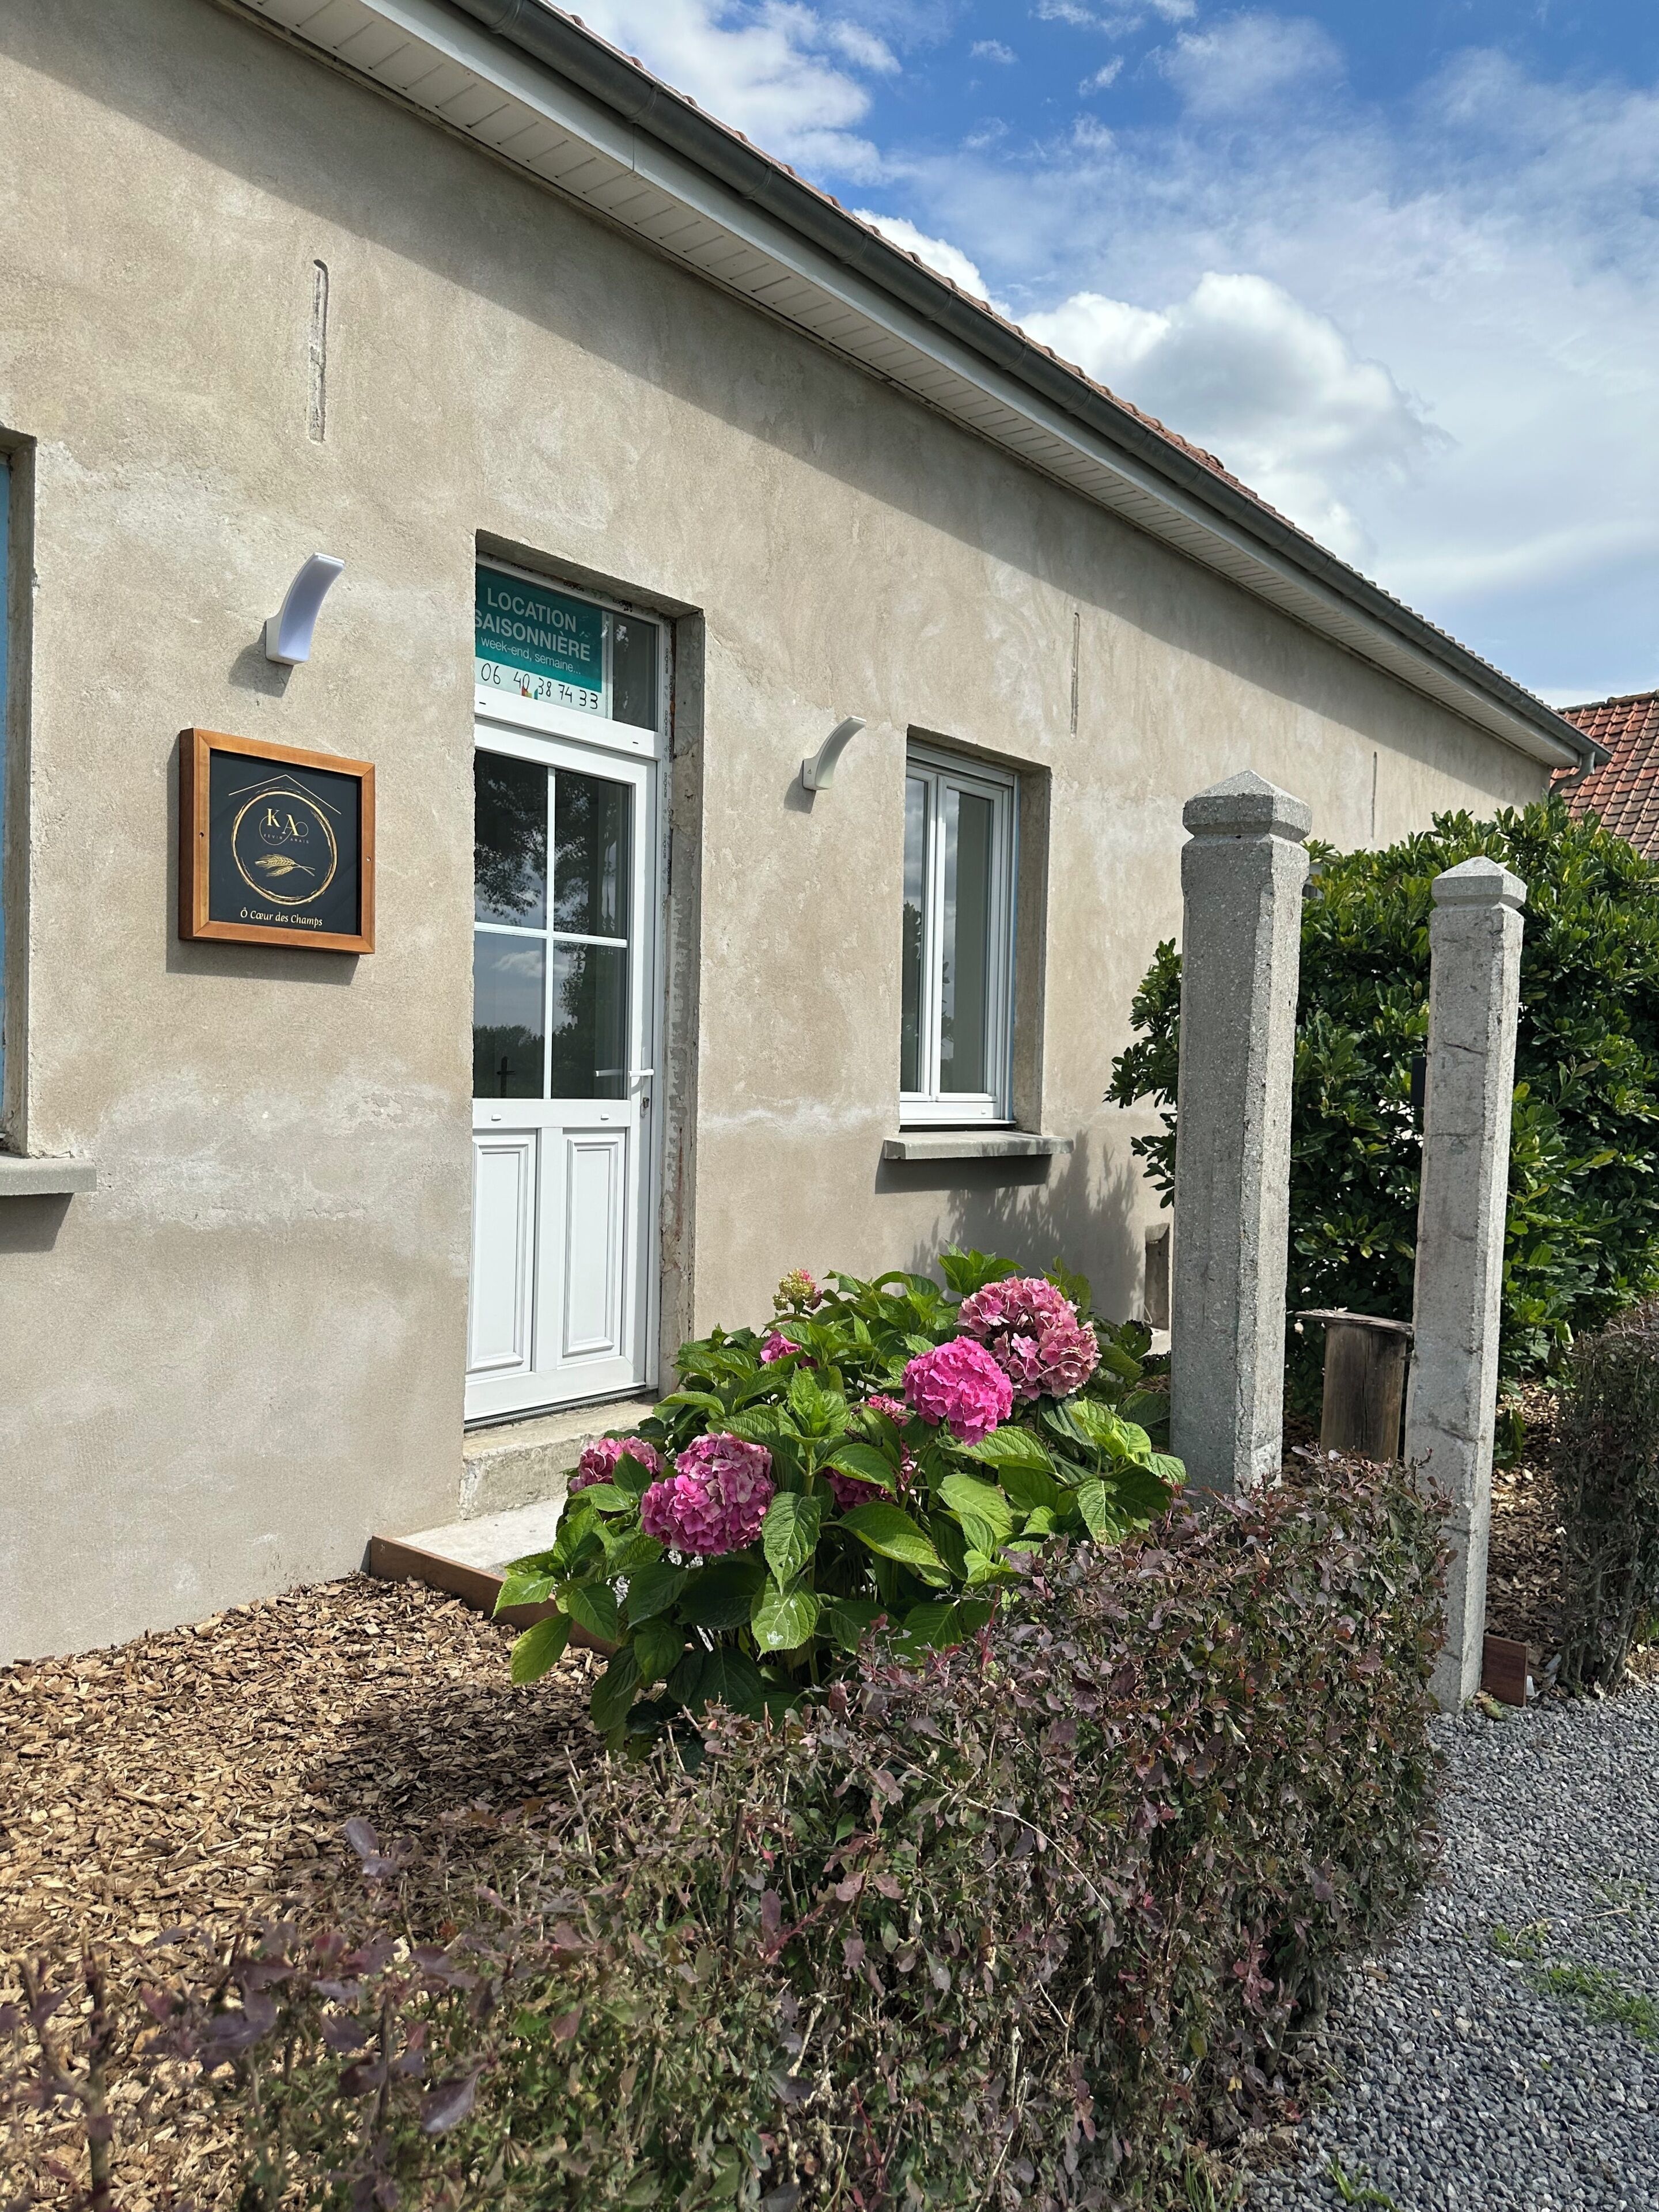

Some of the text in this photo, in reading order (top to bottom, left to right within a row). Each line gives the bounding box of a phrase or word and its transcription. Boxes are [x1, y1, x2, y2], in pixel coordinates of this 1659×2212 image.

[487, 588, 576, 633] LOCATION
[475, 609, 590, 662] SAISONNIÈRE
[481, 637, 581, 675] week-end, semaine...
[481, 663, 598, 709] 06 40 38 74 33
[240, 907, 323, 929] Ô Cœur des Champs
